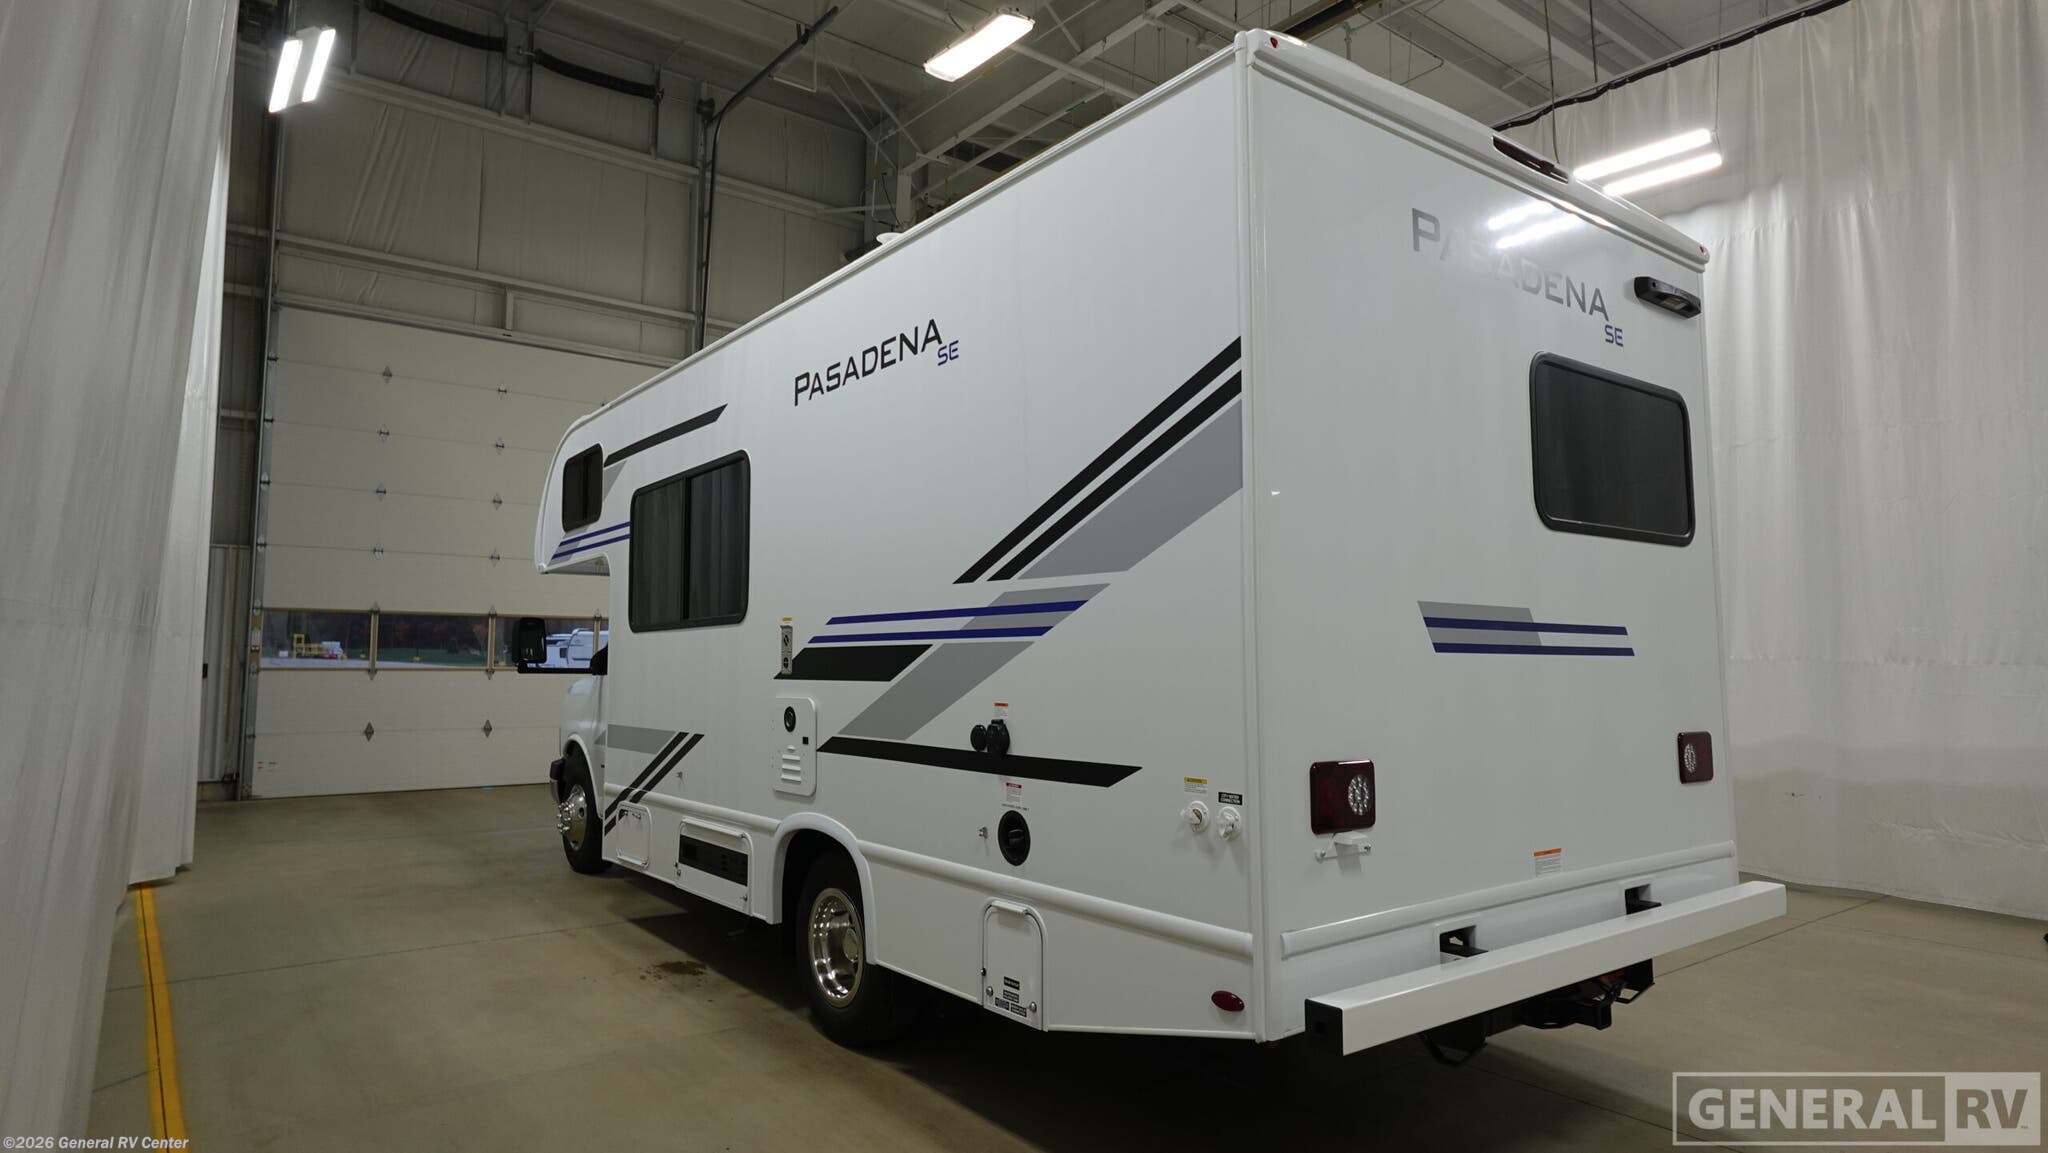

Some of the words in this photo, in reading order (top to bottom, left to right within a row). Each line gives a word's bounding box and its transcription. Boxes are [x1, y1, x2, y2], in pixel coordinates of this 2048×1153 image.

[1604, 324, 1624, 347] SE
[794, 318, 943, 407] PASADENA
[937, 340, 960, 366] SE
